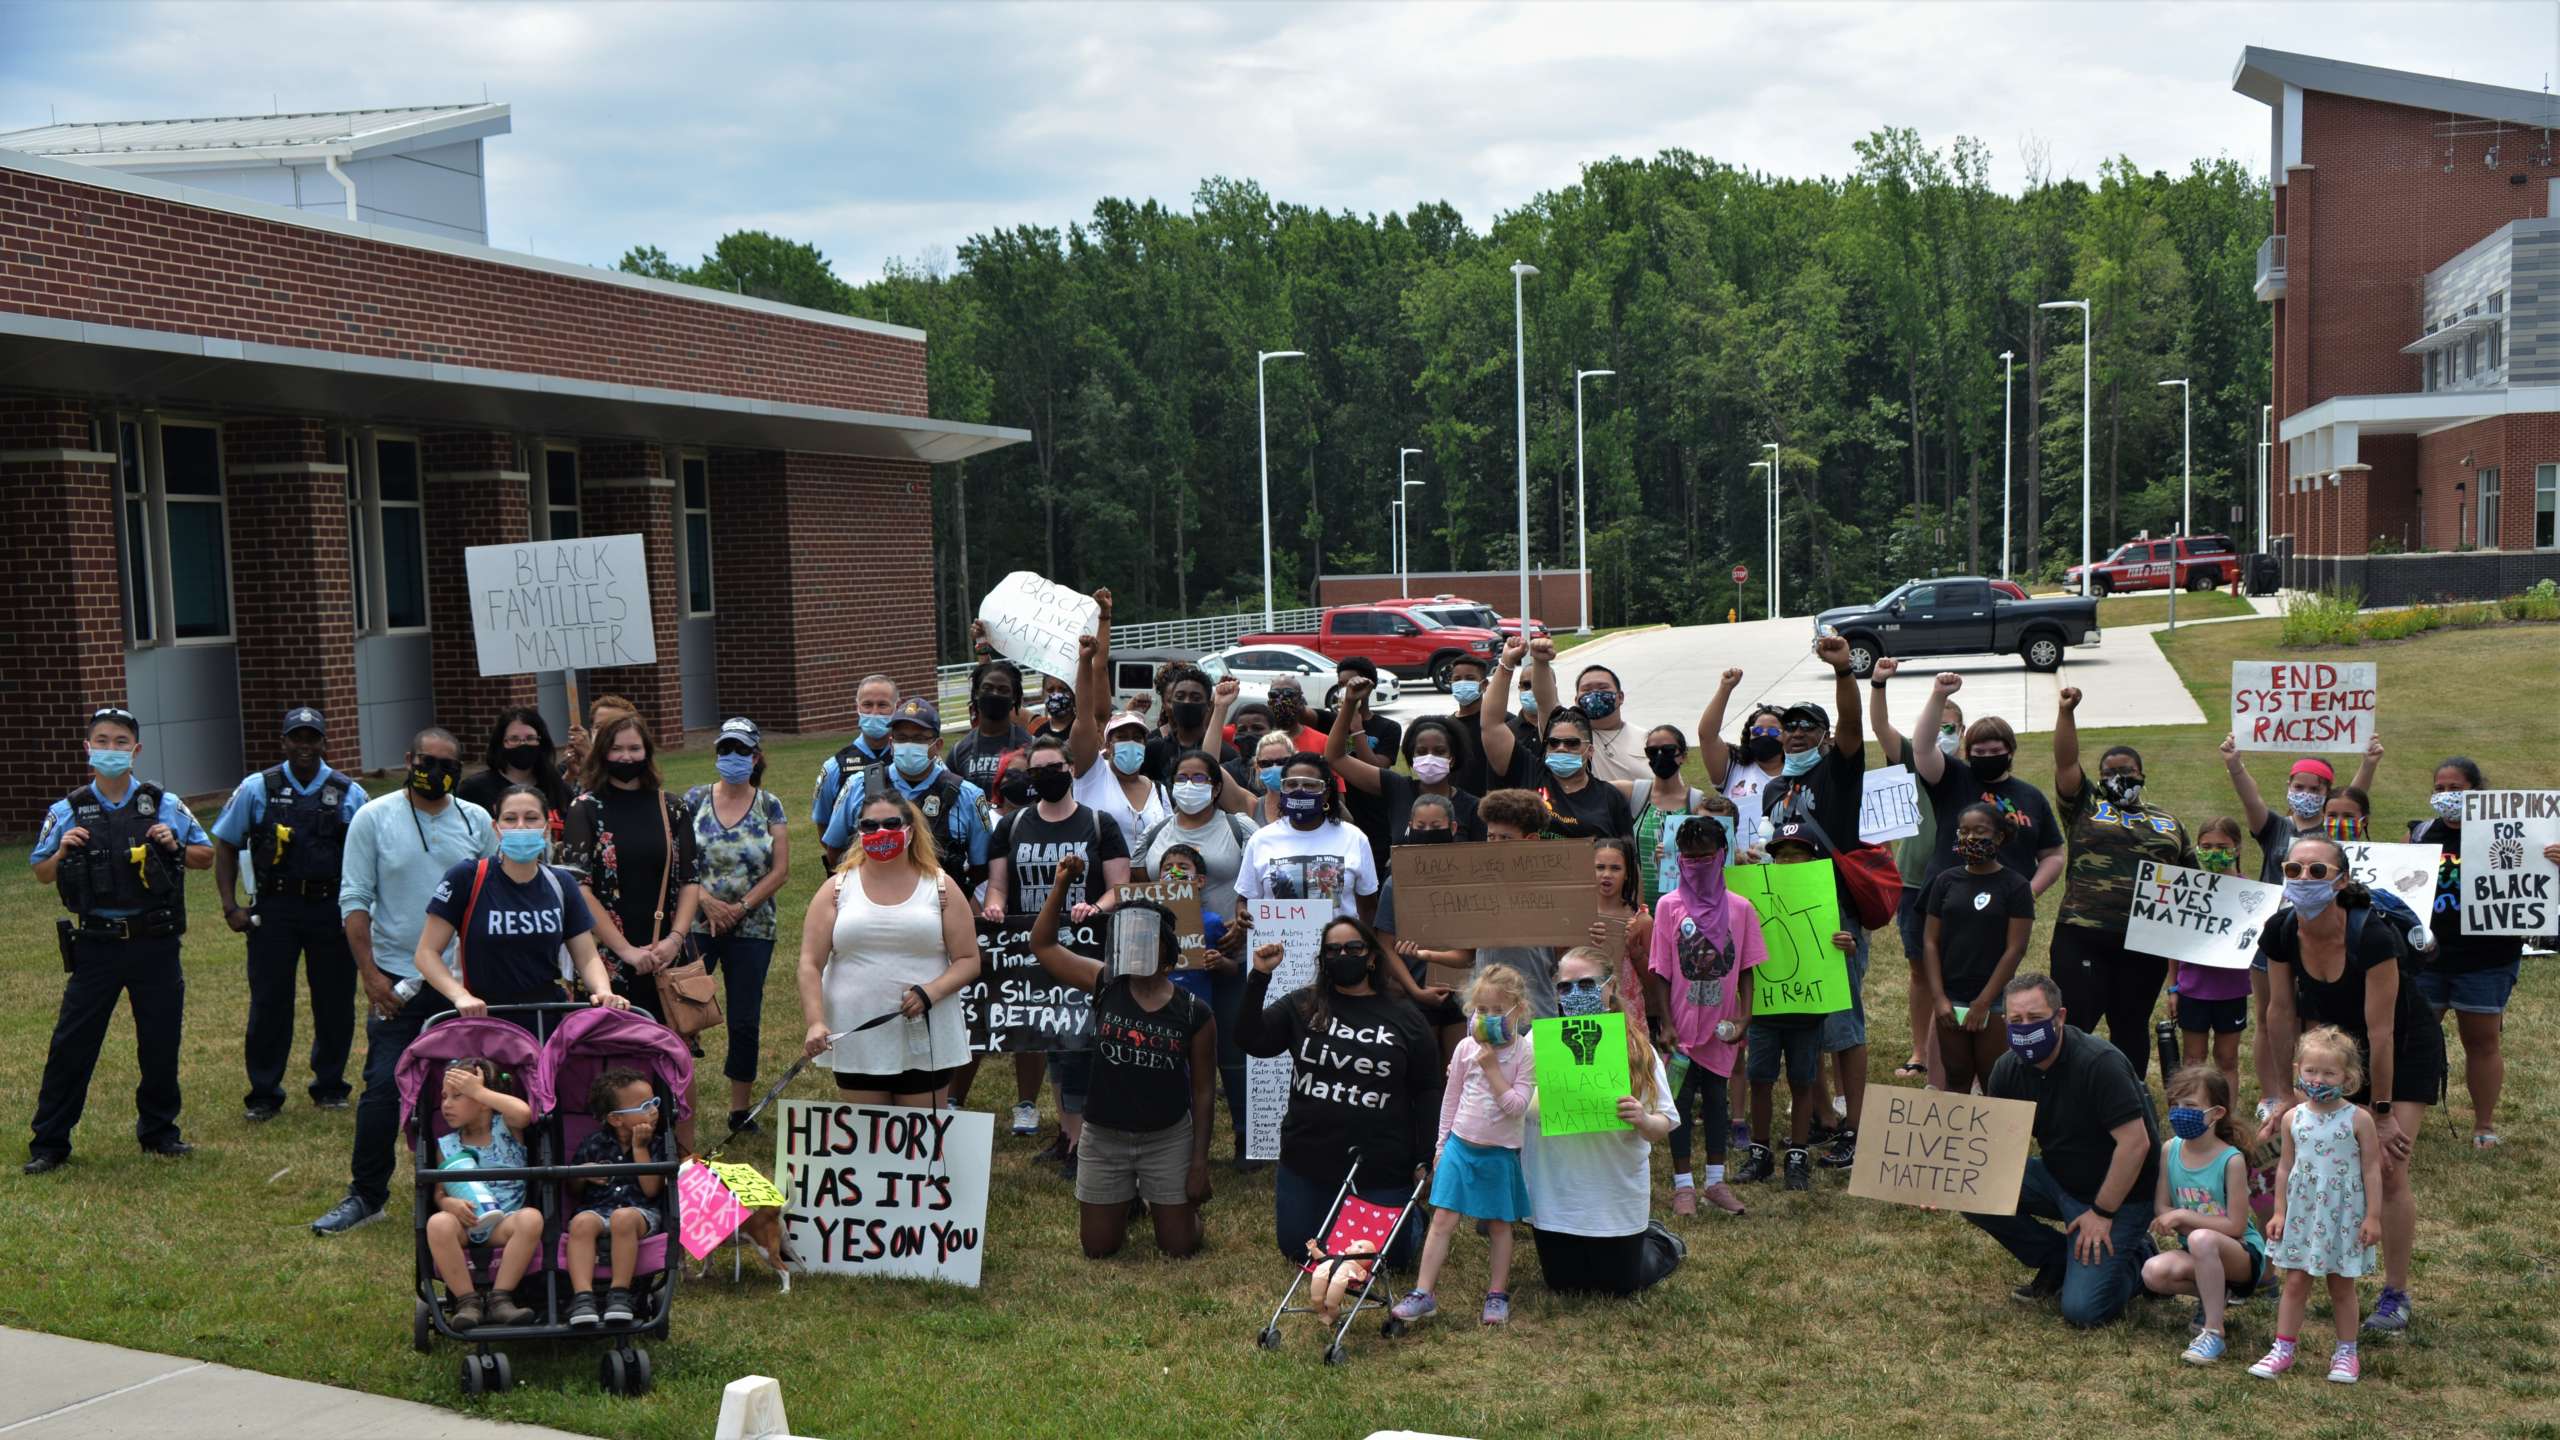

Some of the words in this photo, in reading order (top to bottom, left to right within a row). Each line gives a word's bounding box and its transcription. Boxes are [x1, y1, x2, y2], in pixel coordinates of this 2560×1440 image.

[514, 543, 615, 586] BLACK
[488, 581, 627, 630] FAMILIES
[515, 624, 638, 668] MATTER
[995, 614, 1080, 664] MATTE
[2271, 664, 2337, 689] END
[2236, 689, 2375, 713] SYSTEMIC
[2254, 715, 2356, 744] RACISM
[1862, 783, 1920, 829] ATTER
[2494, 822, 2525, 840] FOR
[1016, 842, 1089, 863] BLACK
[1414, 856, 1459, 875] BLACK
[1120, 883, 1194, 901] RACISM
[1757, 863, 1774, 895] I
[2140, 862, 2222, 893] BLACK
[2474, 873, 2551, 900] BLACK
[1260, 905, 1306, 919] BLM
[2136, 882, 2213, 914] LIVES
[488, 908, 562, 934] RESIST
[2133, 900, 2233, 935] MATTER
[2468, 902, 2546, 931] LIVES
[985, 947, 1040, 971] Time
[1757, 905, 1825, 983] OT
[1328, 1017, 1396, 1046] lack
[1100, 1041, 1179, 1070] QUEEN
[1300, 1037, 1392, 1077] Lives
[1293, 1065, 1391, 1109] Matter
[1546, 1071, 1625, 1094] BLACK
[1562, 1097, 1612, 1113] LIVE
[1889, 1098, 1990, 1134] BLACK
[787, 1106, 954, 1161] HISTORY
[1884, 1130, 1988, 1167] LIVES
[786, 1162, 863, 1208] HAS
[1880, 1161, 1980, 1195] MATTER
[680, 1192, 722, 1252] ACISM
[783, 1213, 887, 1263] EYES
[890, 1225, 926, 1257] ON
[930, 1220, 978, 1264] YOU
